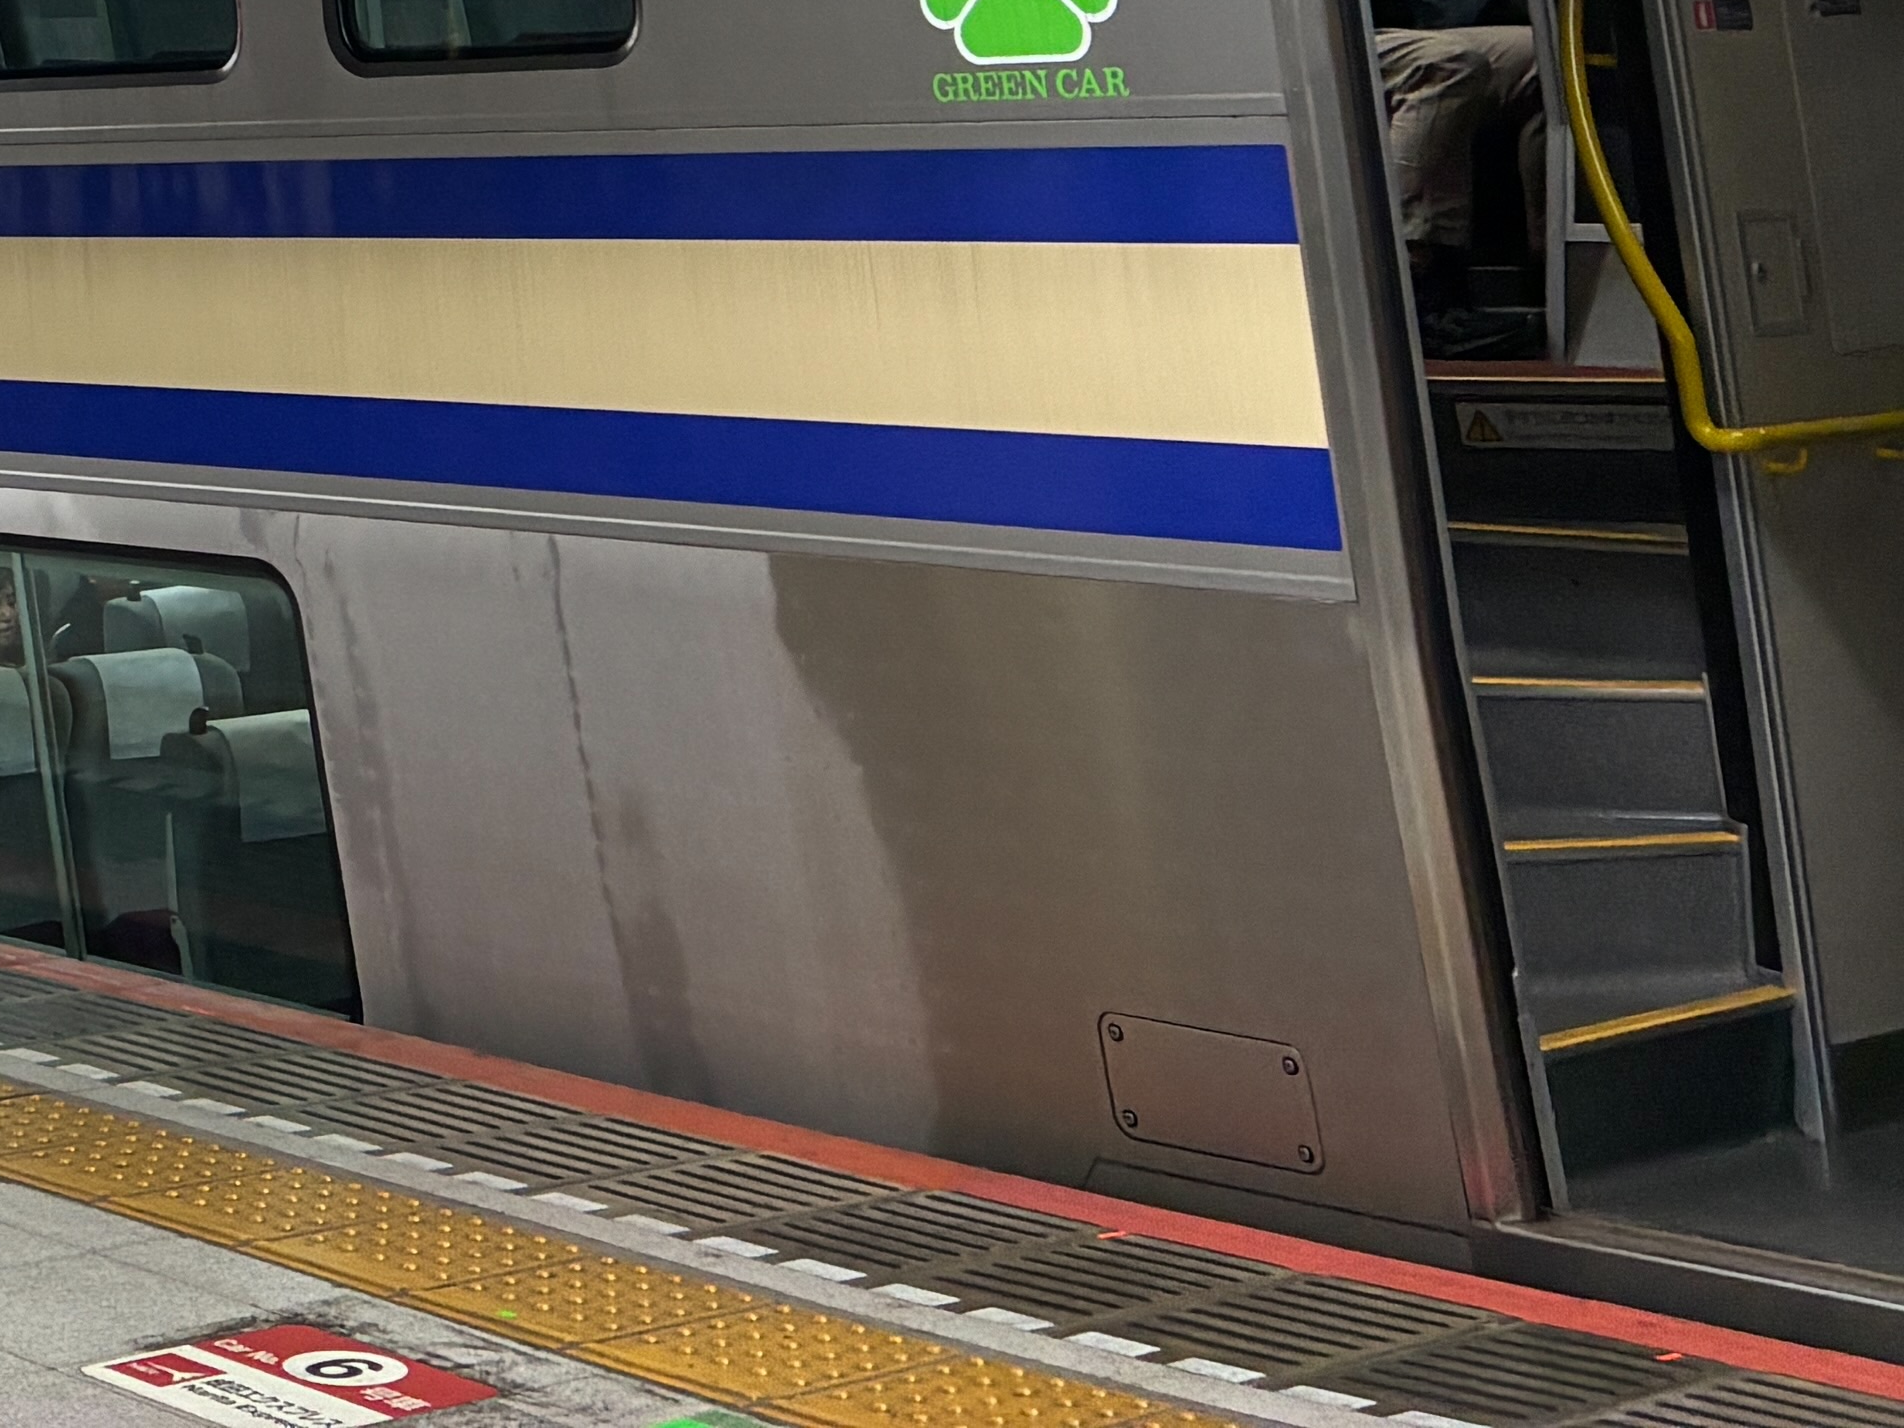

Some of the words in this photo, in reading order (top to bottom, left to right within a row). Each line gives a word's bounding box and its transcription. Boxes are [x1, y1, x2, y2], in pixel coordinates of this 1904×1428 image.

[933, 69, 1048, 103] GREEN
[1056, 67, 1130, 98] CAR
[306, 1358, 385, 1379] 6
[360, 1387, 431, 1412] 号車
